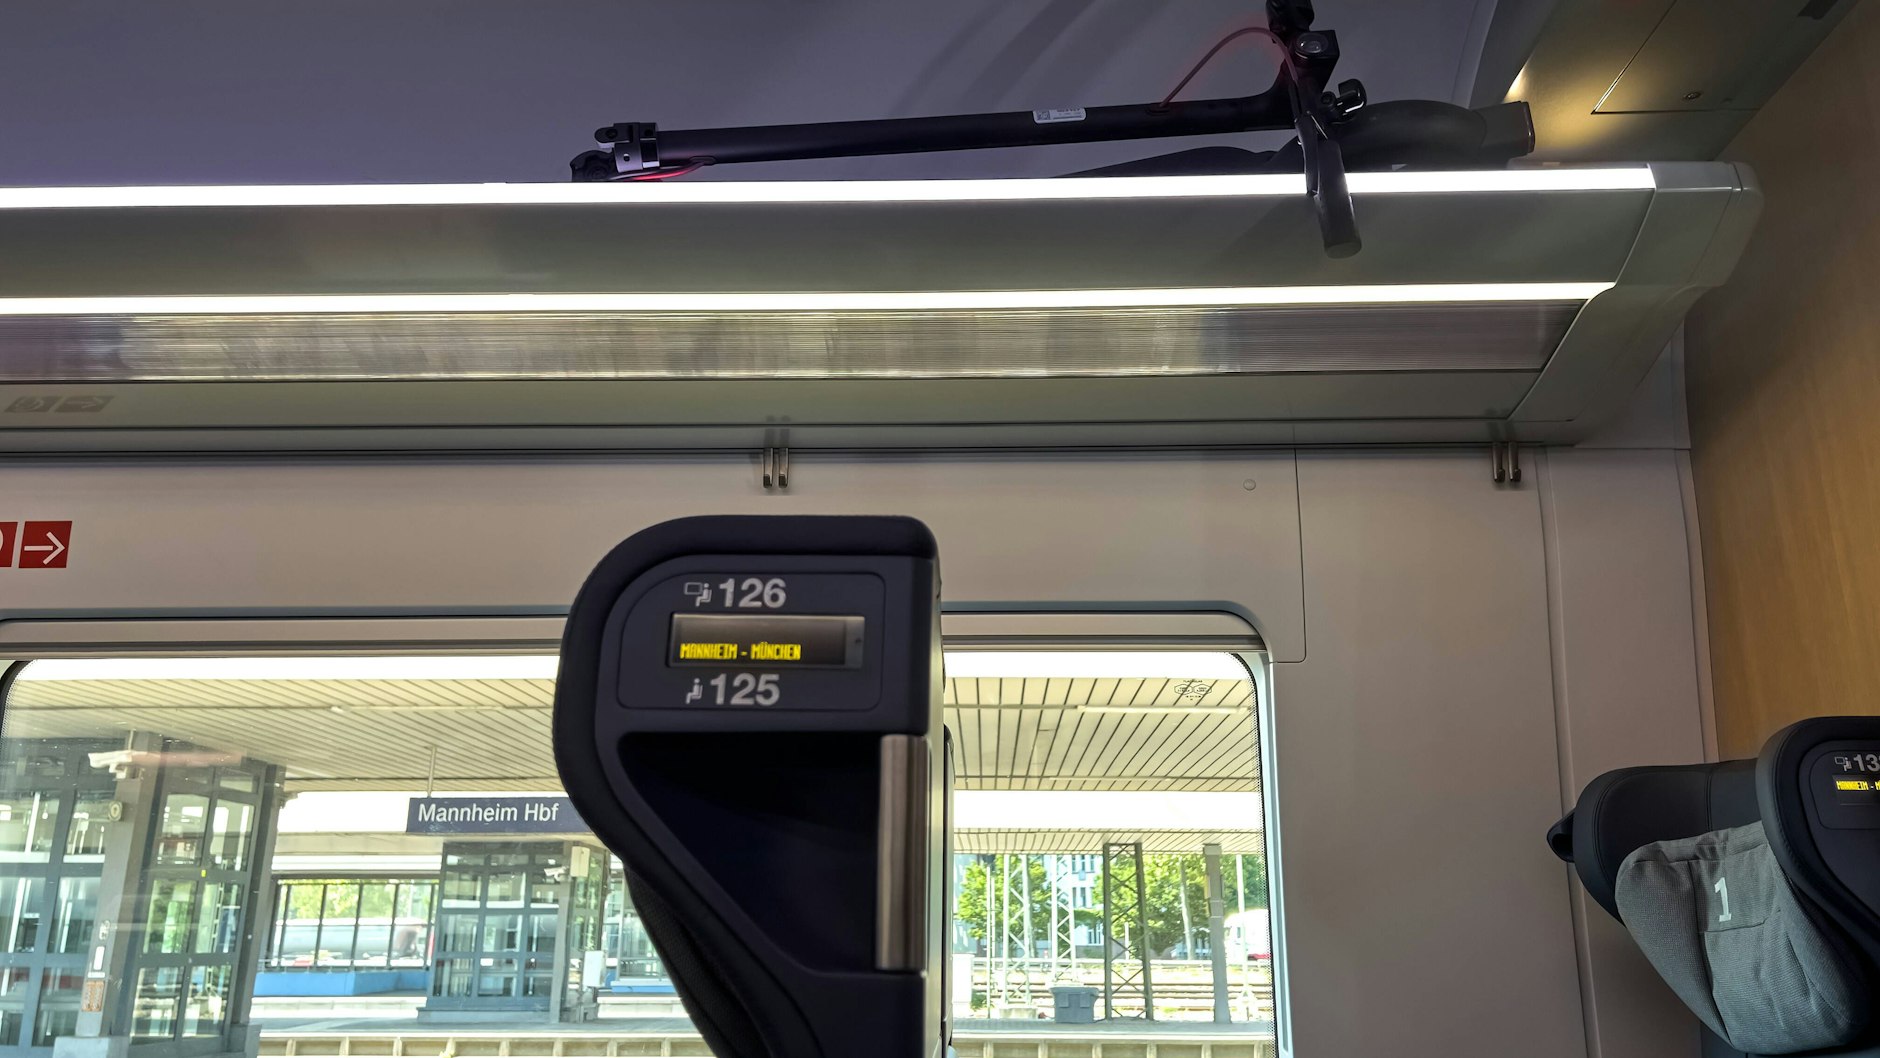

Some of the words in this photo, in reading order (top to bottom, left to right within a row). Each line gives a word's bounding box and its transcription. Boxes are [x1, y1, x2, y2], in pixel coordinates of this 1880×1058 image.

[719, 578, 787, 608] 126
[680, 643, 738, 660] MANNHEIM
[750, 641, 802, 661] MÜNCHEN
[710, 673, 780, 706] 125
[1853, 754, 1880, 772] 13
[418, 802, 518, 823] Mannheim
[524, 802, 560, 822] Hbf
[1714, 876, 1732, 922] 1
